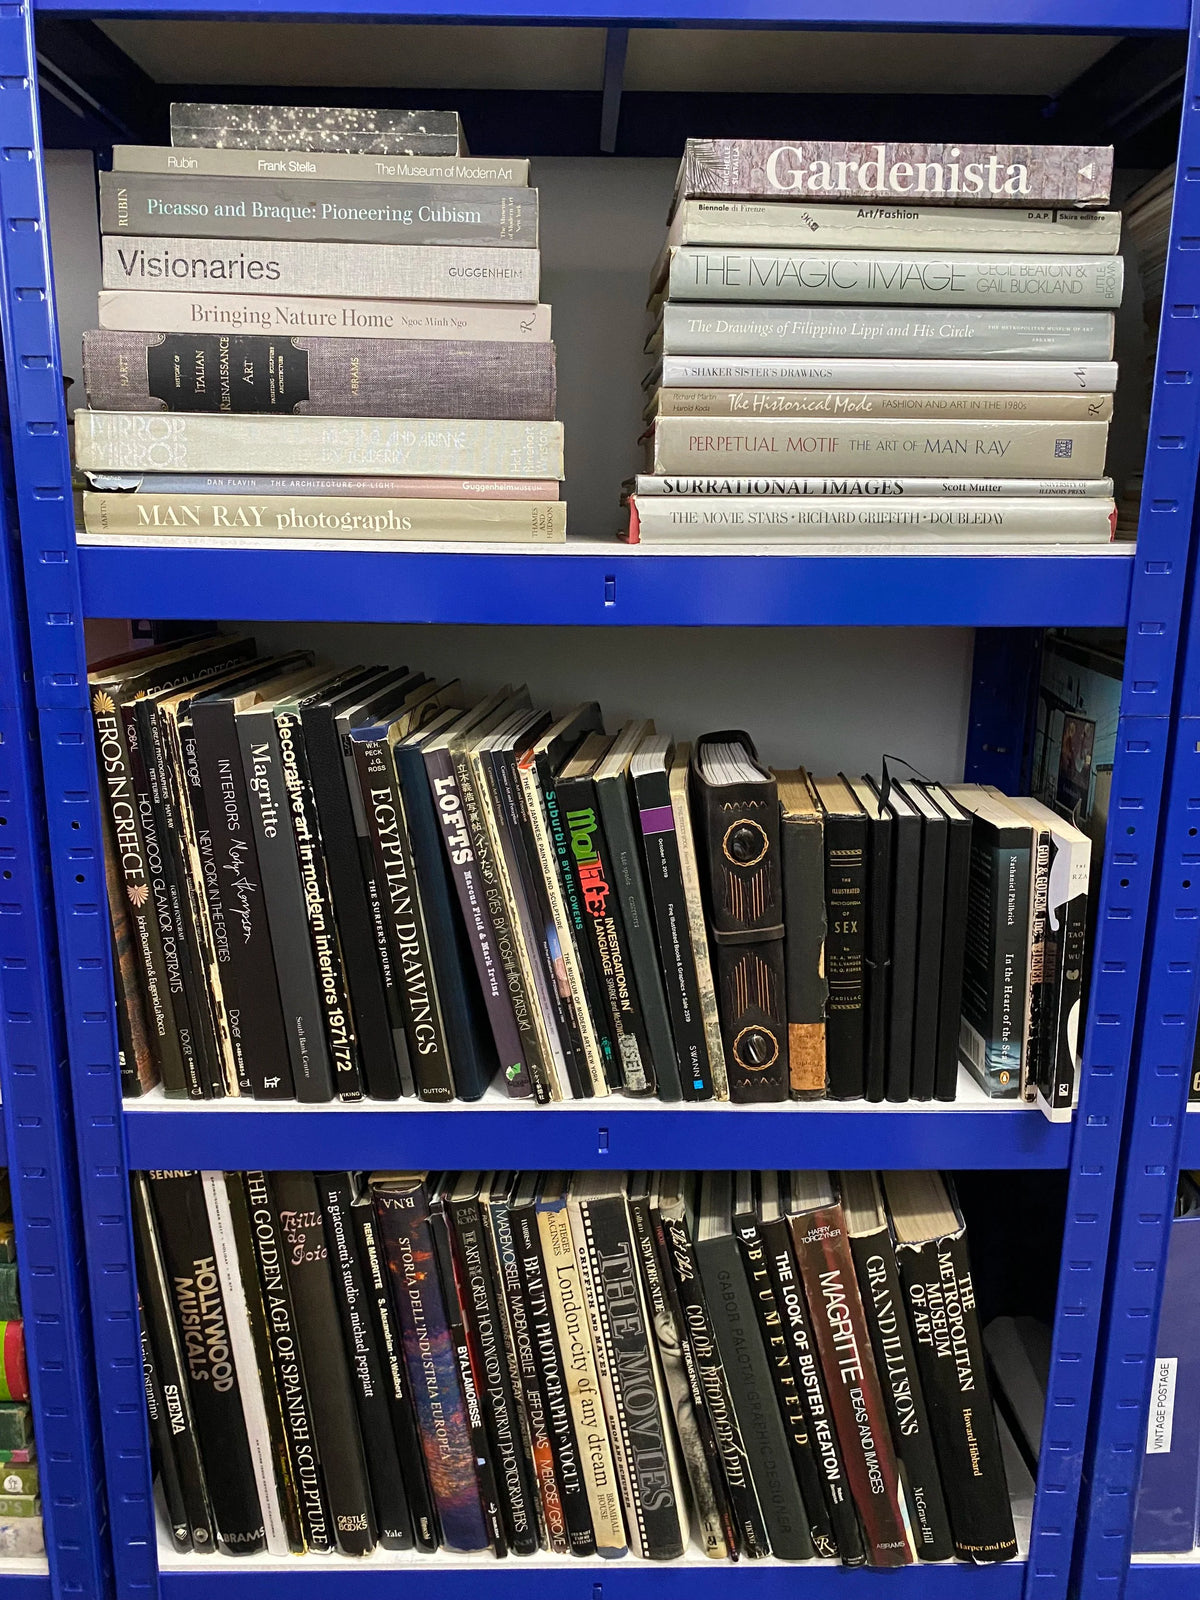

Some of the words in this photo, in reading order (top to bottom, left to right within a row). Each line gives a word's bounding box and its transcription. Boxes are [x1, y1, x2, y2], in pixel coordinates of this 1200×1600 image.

[167, 156, 198, 169] Rubin
[257, 159, 287, 172] Frank
[288, 161, 316, 173] Stella
[375, 163, 396, 176] The
[397, 164, 442, 178] Museum
[444, 165, 455, 177] of
[456, 166, 497, 180] Modern
[498, 168, 513, 180] Art
[766, 146, 1032, 194] Gardenista
[118, 187, 128, 227] RUBIN
[147, 198, 208, 216] Picasso
[214, 202, 246, 217] and
[252, 203, 316, 222] Braque:
[321, 204, 414, 226] Pioneering
[418, 206, 482, 224] Cubism
[698, 204, 730, 212] Biennale
[731, 204, 738, 212] di
[739, 205, 766, 213] Firenze
[856, 208, 920, 220] Art/Fashion
[117, 249, 281, 280] Visionaries
[690, 255, 741, 286] THE
[749, 257, 858, 289] MAGIC
[868, 258, 966, 292] IMAGE
[190, 304, 271, 328] Bringing
[274, 306, 337, 326] Nature
[342, 309, 394, 328] Home
[688, 320, 712, 332] The
[716, 320, 774, 336] Drawings
[776, 321, 790, 339] of
[792, 322, 847, 340] Filippino
[850, 322, 884, 340] Lippi
[886, 324, 908, 336] and
[912, 324, 935, 338] His
[939, 324, 974, 338] Circle
[195, 350, 206, 394] ITALIAN
[220, 336, 232, 412] RENAISSANCE
[242, 360, 254, 384] ART
[728, 393, 749, 412] The
[753, 394, 832, 413] Historical
[834, 394, 873, 413] Mode
[882, 400, 923, 408] FASHION
[926, 400, 948, 408] AND
[950, 400, 967, 409] ART
[970, 401, 980, 409] IN
[984, 401, 1000, 410] THE
[1004, 402, 1027, 410] 1980s
[688, 436, 778, 452] PERPETUAL
[786, 438, 840, 453] MOTIF
[850, 440, 870, 451] THE
[876, 440, 899, 451] ART
[902, 440, 919, 451] OF
[924, 440, 968, 454] MAN
[975, 440, 1011, 458] RAY
[662, 479, 814, 495] SURRATIONAL
[822, 480, 904, 495] IMAGES
[942, 482, 966, 492] Scott
[969, 483, 1002, 492] Mutter
[138, 504, 200, 526] MAN
[212, 505, 268, 527] RAY
[276, 508, 412, 533] photographs
[96, 716, 125, 773] EROS
[127, 724, 138, 752] KOBAL
[278, 714, 305, 814] decorative
[368, 765, 386, 773] ROSS
[107, 776, 134, 798] IN
[218, 759, 241, 832] INTERIORS
[250, 742, 279, 839] Magritte
[138, 792, 163, 874] HOLLYWOOD
[294, 814, 314, 841] art
[434, 775, 474, 865] LOFTS
[546, 790, 566, 855] Suburbia
[112, 802, 144, 880] GREECE
[300, 843, 316, 860] in
[562, 860, 570, 872] BY
[564, 874, 574, 894] BILL
[1008, 856, 1018, 892] Nathaniel
[152, 878, 174, 933] GLAMOR
[302, 862, 325, 936] modern
[368, 879, 378, 899] THE
[370, 788, 414, 916] EGYPTIAN
[396, 922, 438, 1055] DRAWINGS
[372, 901, 386, 944] SURFER'S
[570, 894, 584, 930] OWENS
[834, 920, 858, 934] SEX
[1008, 892, 1016, 926] Philbrick
[162, 936, 184, 994] PORTRAITS
[316, 936, 339, 1006] interiors
[379, 946, 393, 988] JOURNAL
[1004, 954, 1014, 965] In
[1004, 966, 1014, 983] the
[1002, 986, 1013, 1013] Heart
[1002, 1014, 1012, 1026] of
[1002, 1028, 1011, 1042] the
[328, 1007, 353, 1073] 1971/72
[1001, 1044, 1010, 1061] Sea
[690, 1044, 700, 1078] SWANN
[247, 1170, 268, 1206] THE
[254, 1209, 284, 1291] GOLDEN
[363, 1222, 375, 1246] RENE
[368, 1246, 384, 1290] MAGRITTE
[776, 1250, 793, 1282] THE
[523, 1255, 549, 1317] BEAUTY
[598, 1242, 645, 1340] THE
[909, 1284, 927, 1307] OF
[958, 1272, 976, 1313] THE
[193, 1256, 234, 1392] HOLLYWOOD
[268, 1296, 291, 1334] AGE
[556, 1263, 591, 1372] London-city
[782, 1284, 804, 1328] LOOK
[926, 1282, 953, 1359] MUSEUM
[937, 1251, 976, 1392] METROPOLITAN
[174, 1276, 210, 1382] MUSICALS
[793, 1330, 810, 1351] OF
[818, 1269, 864, 1385] MAGRITTE
[866, 1254, 898, 1334] GRAND
[882, 1336, 920, 1437] ILLUSIONS
[914, 1310, 935, 1347] ART
[276, 1336, 296, 1361] OF
[398, 1238, 418, 1287] STORIA
[408, 1289, 440, 1399] DELL'INDUSTRIA
[430, 1402, 452, 1461] EUROPEA
[535, 1322, 570, 1435] PHOTOGRAPHY
[578, 1377, 597, 1396] of
[685, 1304, 712, 1358] COLOR
[701, 1364, 747, 1489] PHOTOGRAPHY
[798, 1354, 826, 1417] BUSTER
[1157, 1362, 1170, 1408] POSTAGE
[164, 1384, 186, 1436] SIENA
[280, 1364, 310, 1441] SPANISH
[581, 1398, 598, 1428] any
[850, 1386, 869, 1423] IDEAS
[614, 1344, 674, 1511] MOVIES
[858, 1424, 875, 1450] AND
[1154, 1409, 1166, 1450] VINTAGE
[558, 1442, 581, 1495] VOGUE
[588, 1432, 608, 1488] dream
[814, 1418, 841, 1481] KEATON
[864, 1451, 885, 1495] IMAGES
[295, 1445, 328, 1545] SCULPTURE
[384, 1528, 403, 1538] Yale
[913, 1487, 935, 1545] McGraw-Hill
[216, 1527, 265, 1544] ABRAMS
